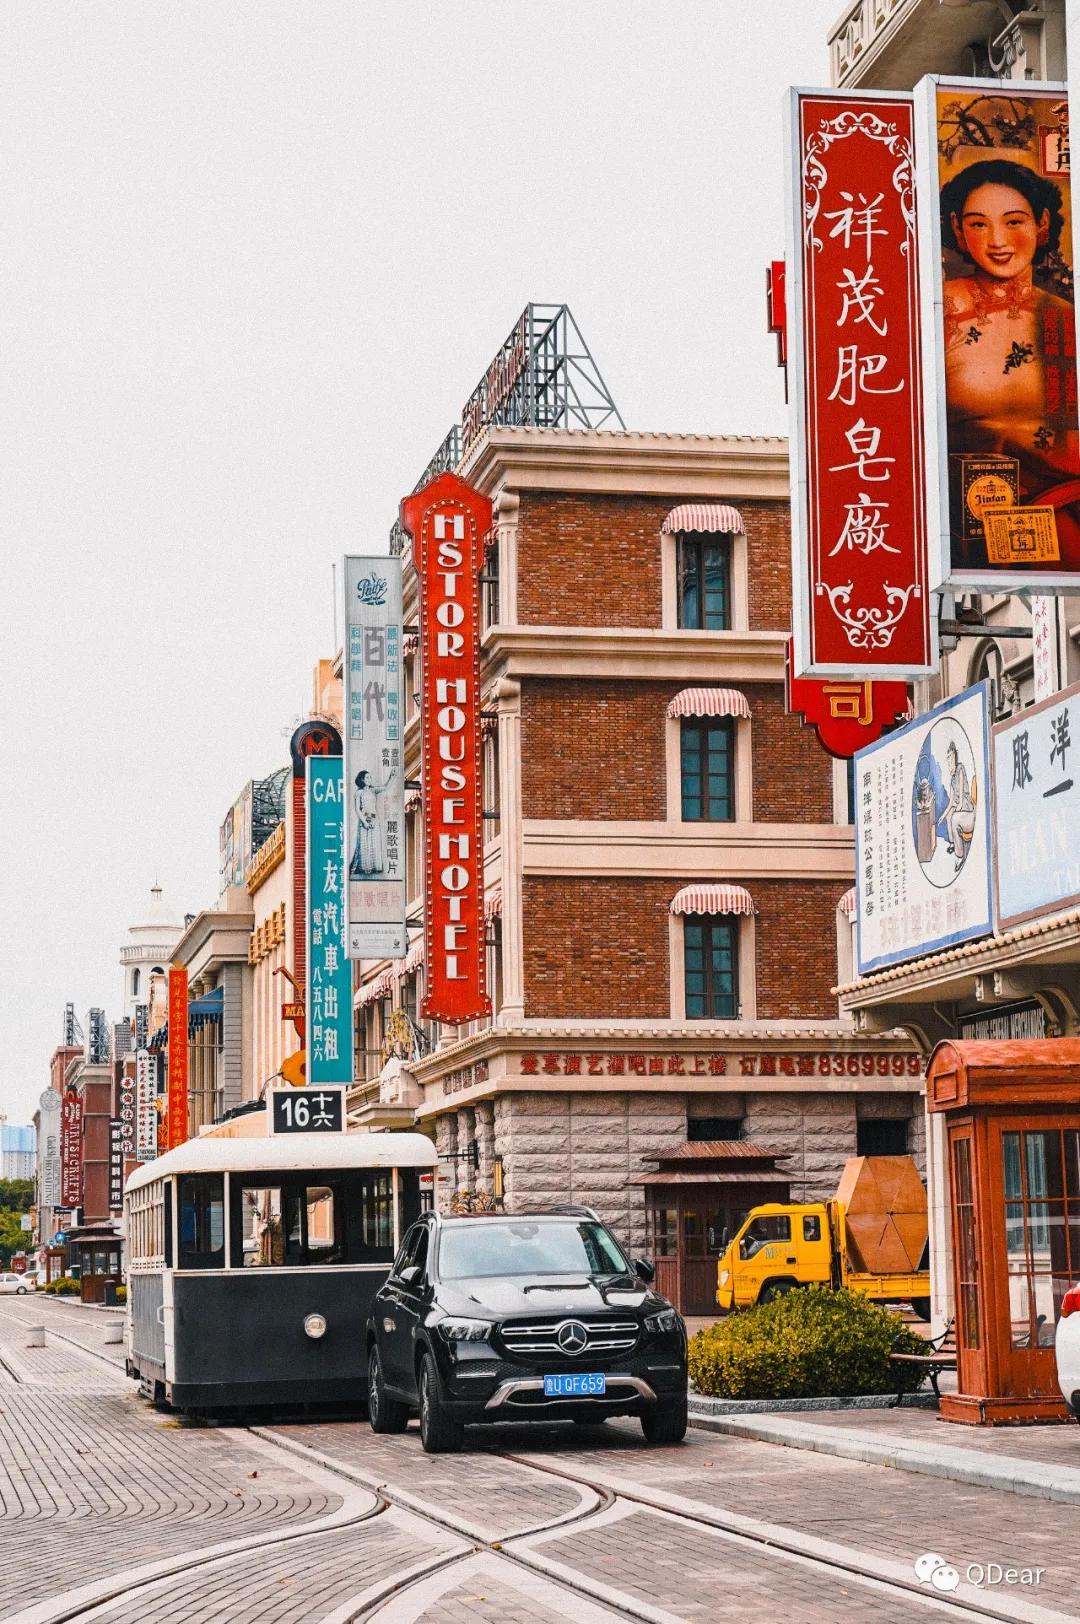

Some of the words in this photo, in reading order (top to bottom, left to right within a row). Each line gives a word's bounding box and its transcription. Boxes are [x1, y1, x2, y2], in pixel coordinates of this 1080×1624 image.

[824, 192, 904, 557] 祥茂肥皂廠
[433, 514, 465, 657] HSTOR
[364, 626, 387, 722] 百代
[436, 678, 467, 824] HOUSE
[438, 832, 470, 980] HOTEL
[281, 1098, 310, 1127] 16
[311, 1093, 335, 1127] 十六
